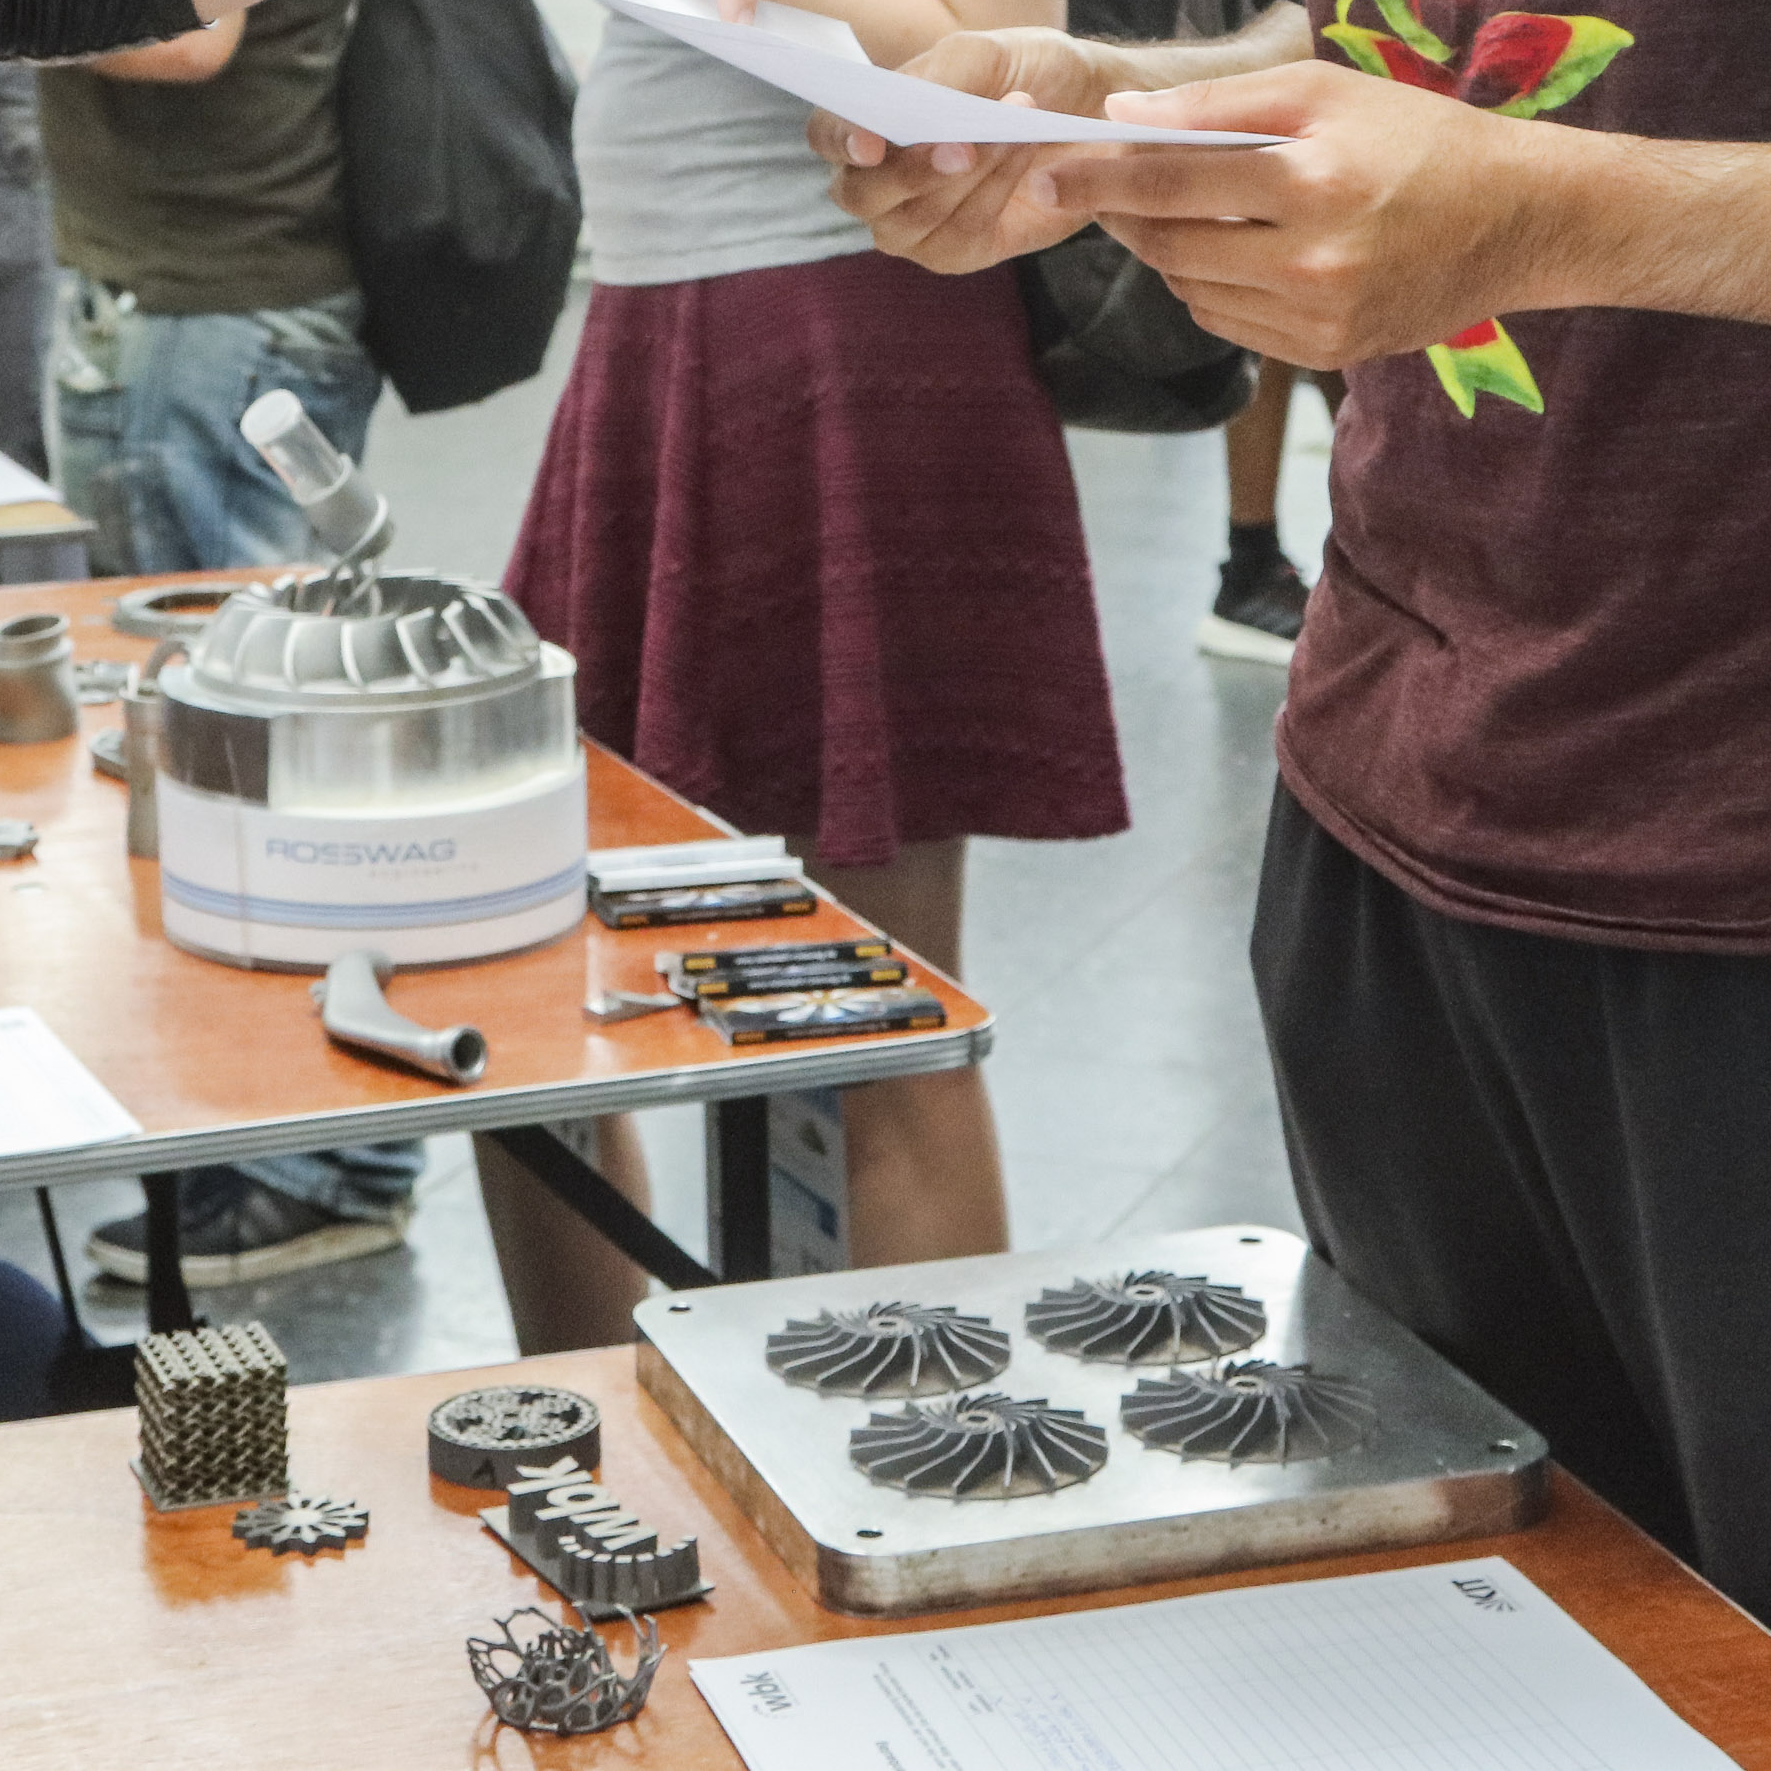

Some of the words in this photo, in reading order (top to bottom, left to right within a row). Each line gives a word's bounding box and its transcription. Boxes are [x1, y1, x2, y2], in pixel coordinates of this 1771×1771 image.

[265, 837, 458, 866] ROSSWAG
[506, 1455, 659, 1552] wbk
[739, 1670, 793, 1714] wbk
